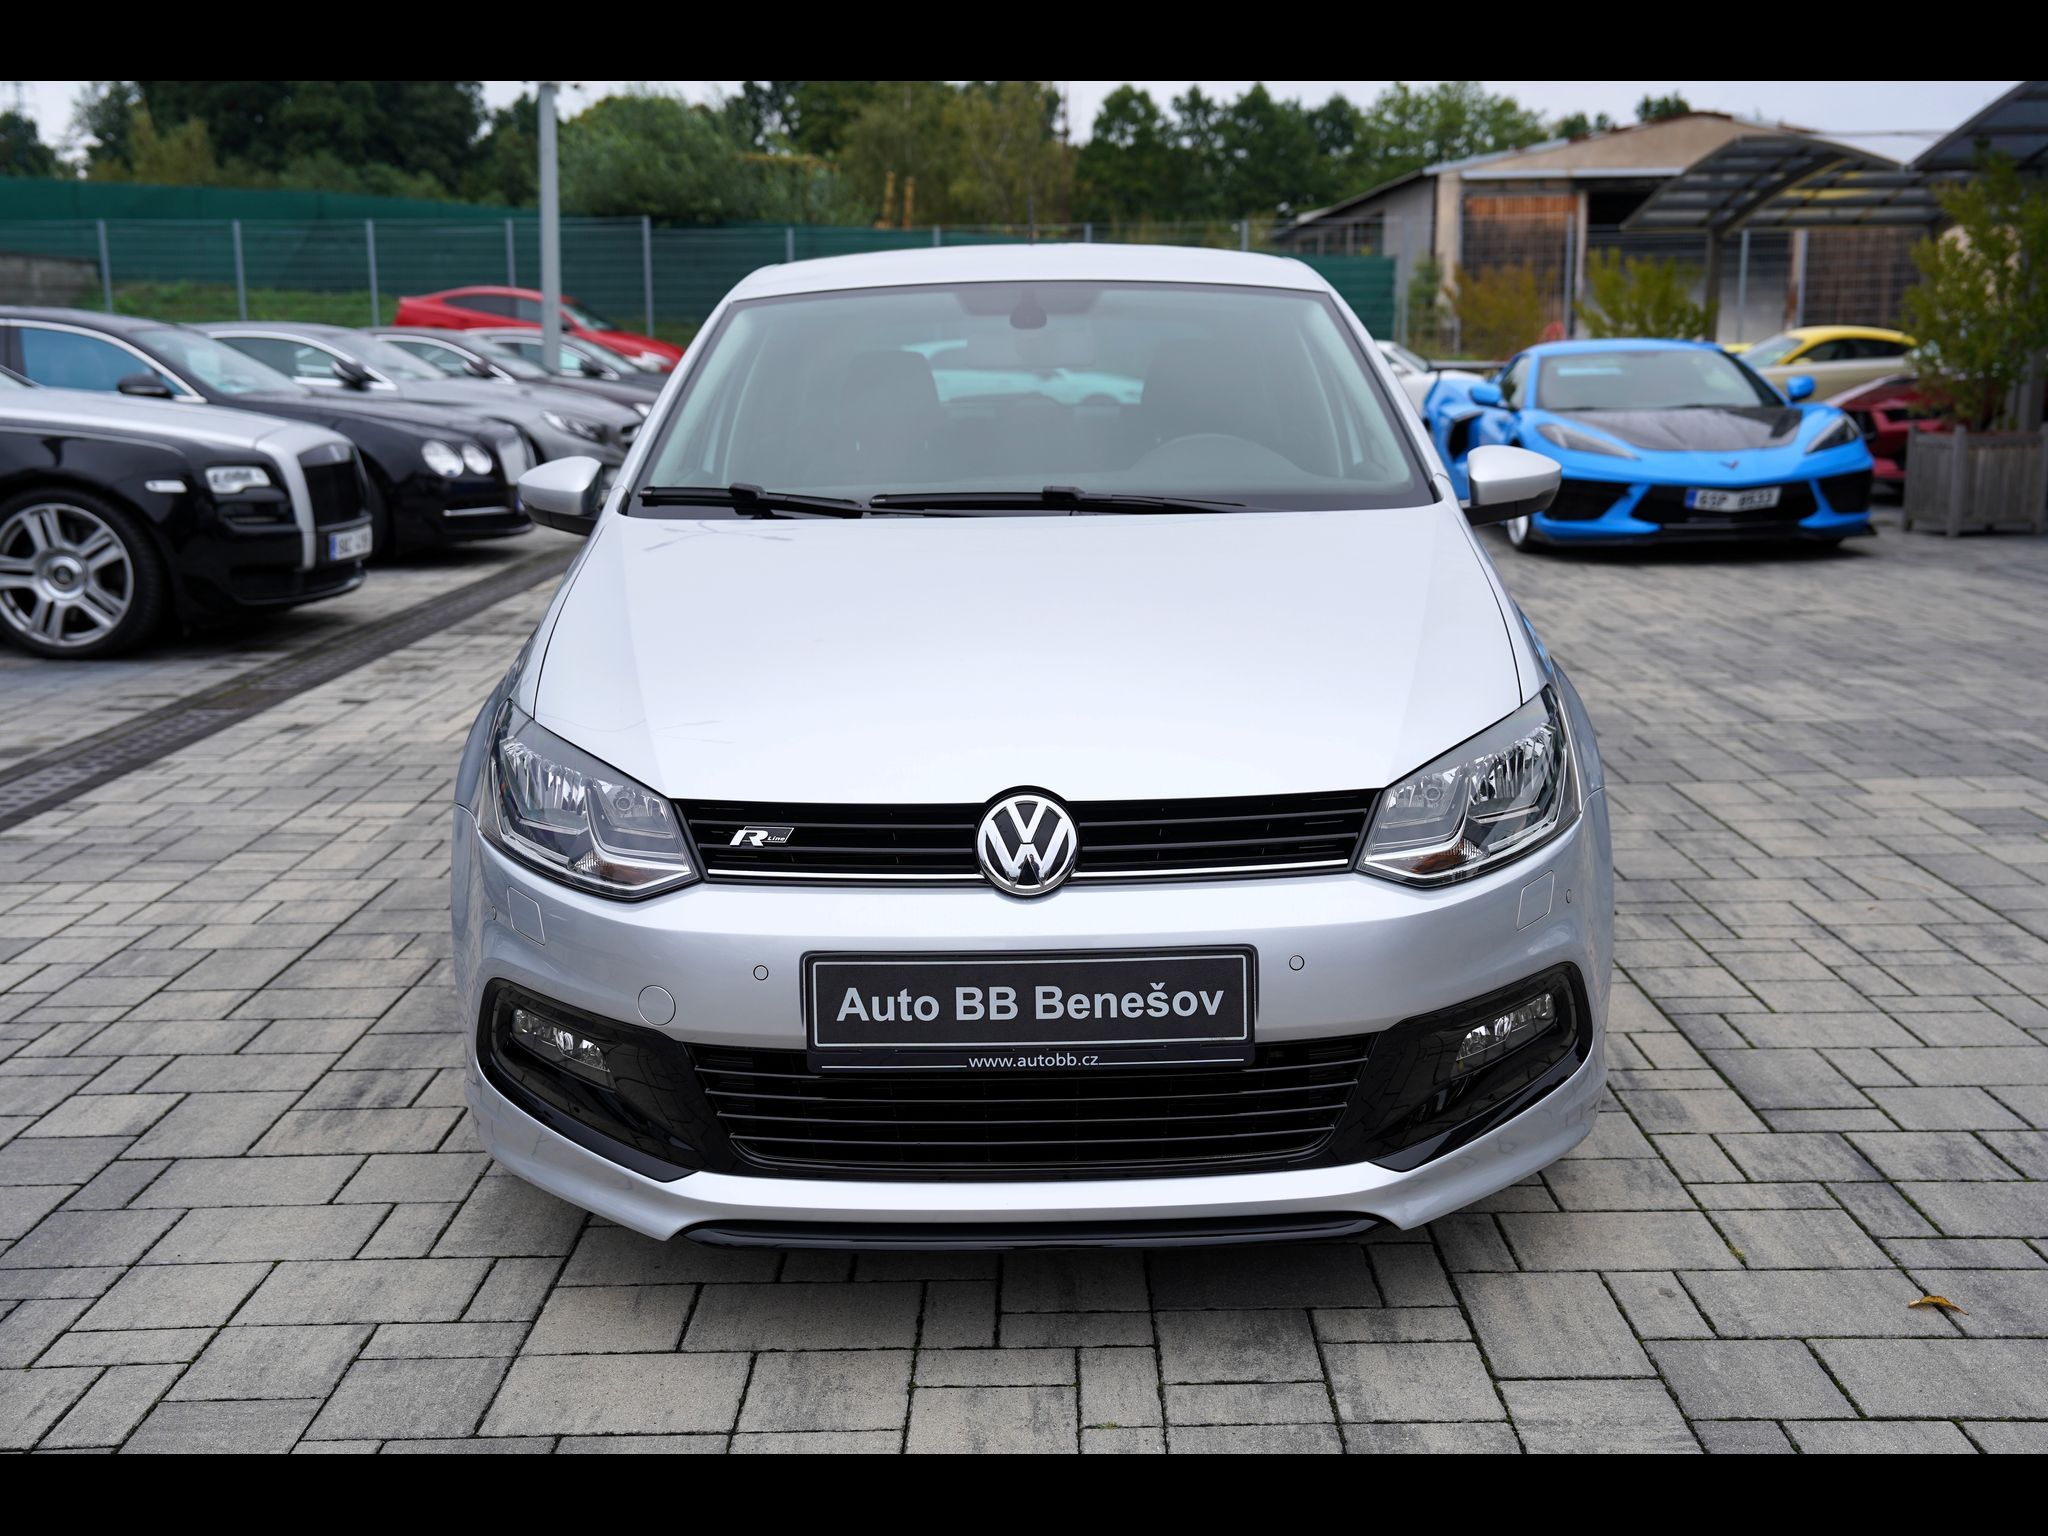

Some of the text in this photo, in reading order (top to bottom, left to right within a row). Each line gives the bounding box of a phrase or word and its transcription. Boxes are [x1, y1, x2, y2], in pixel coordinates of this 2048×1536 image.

[729, 829, 768, 847] R
[836, 981, 1225, 1022] Auto BB Benešov
[968, 1052, 1100, 1069] www.autobb.cz
